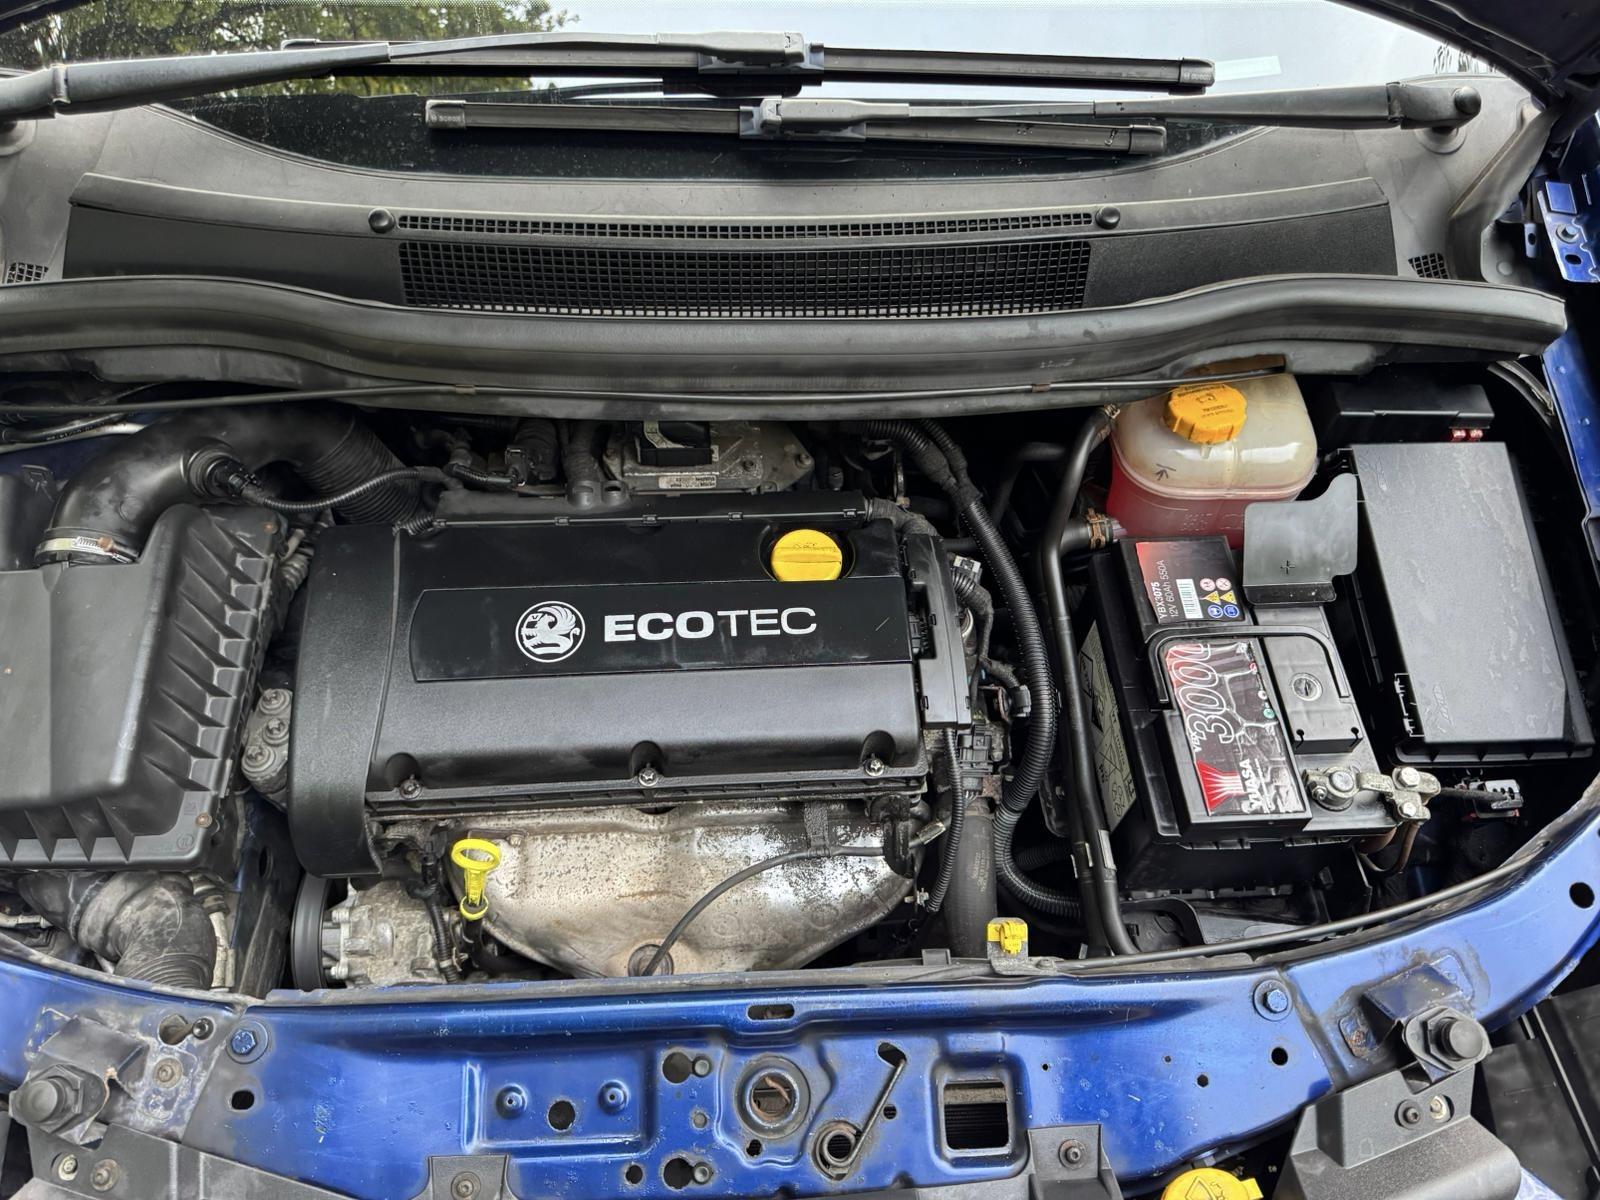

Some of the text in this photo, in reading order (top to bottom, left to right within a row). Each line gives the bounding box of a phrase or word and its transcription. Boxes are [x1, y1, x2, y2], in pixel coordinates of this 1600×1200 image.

[1151, 581, 1168, 619] YBX3075
[1156, 560, 1179, 618] 12V 60Ah 550A
[604, 607, 817, 642] ECOTEC
[1239, 758, 1263, 809] YUASA
